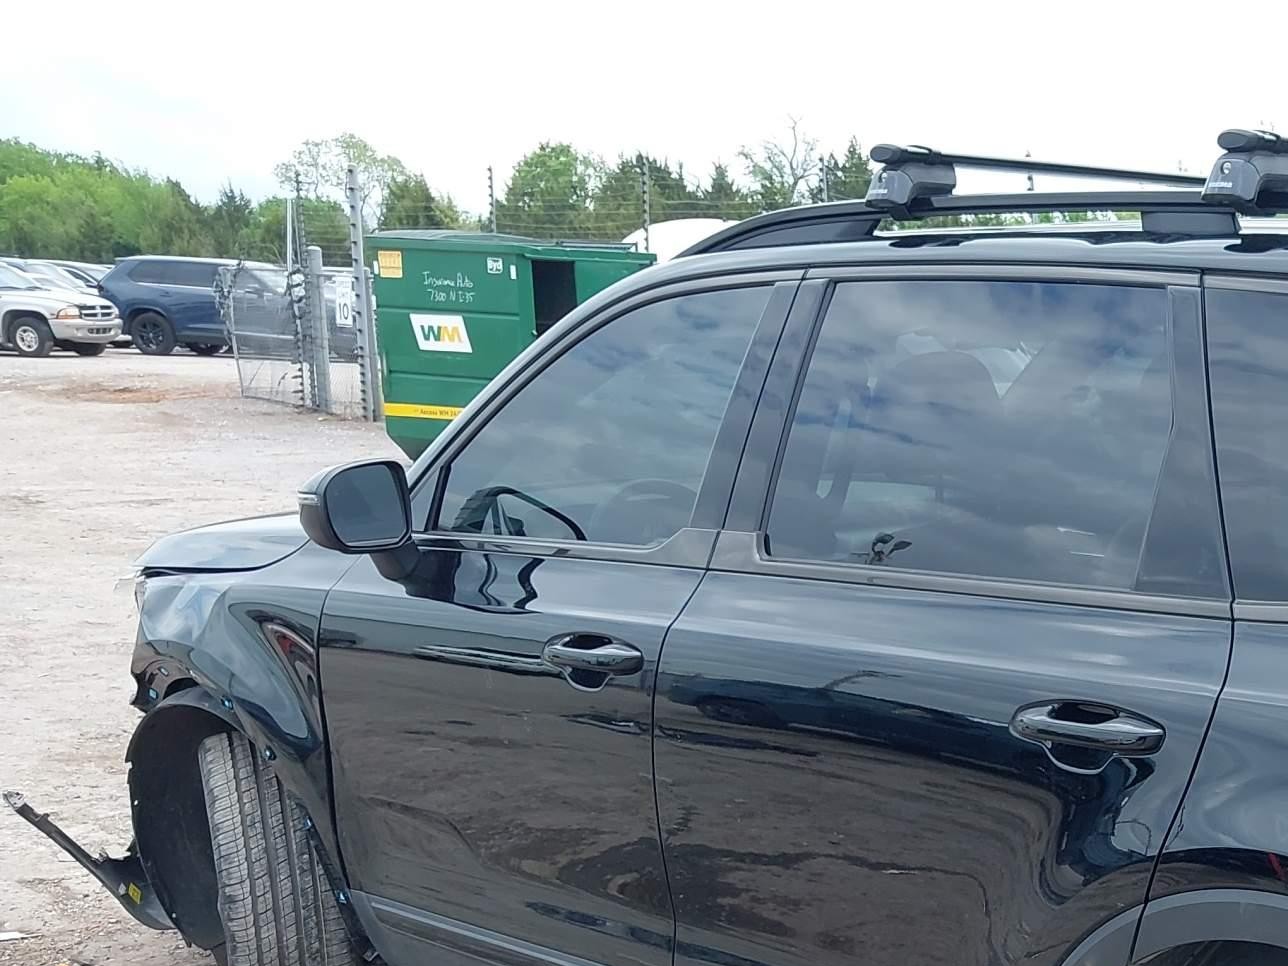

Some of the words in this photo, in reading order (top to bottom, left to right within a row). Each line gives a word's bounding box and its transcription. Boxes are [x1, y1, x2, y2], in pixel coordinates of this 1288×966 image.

[456, 272, 474, 288] Auto
[426, 289, 447, 302] 7300
[449, 290, 456, 302] N
[420, 324, 463, 344] WM
